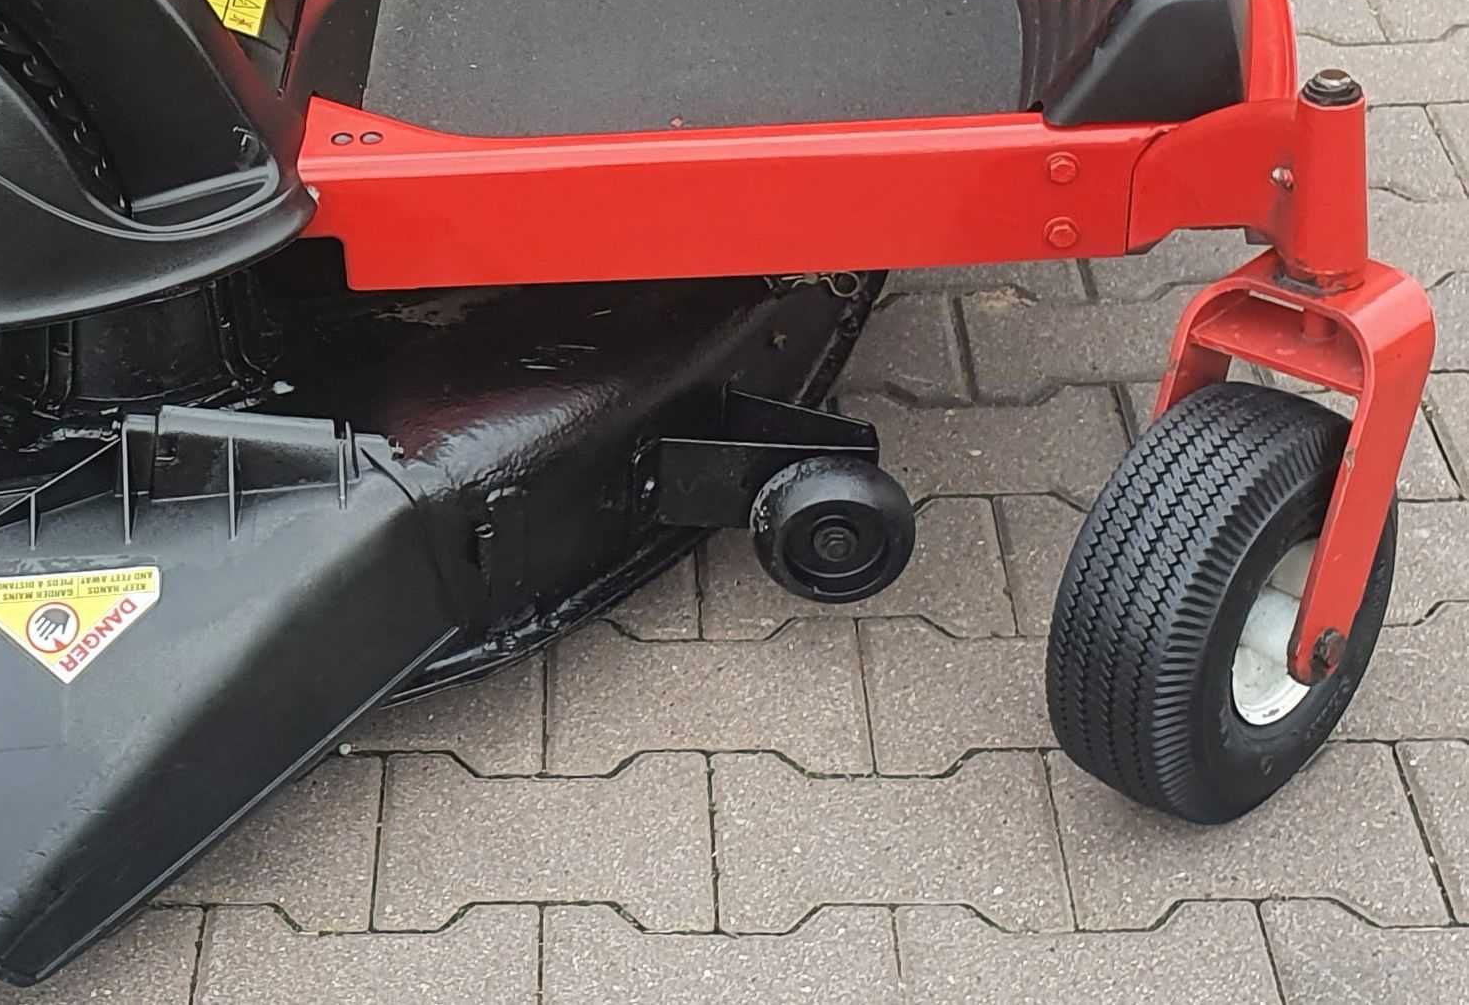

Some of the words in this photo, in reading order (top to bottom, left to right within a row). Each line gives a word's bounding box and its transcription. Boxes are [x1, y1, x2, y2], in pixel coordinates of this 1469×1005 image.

[80, 575, 107, 584] AWAY
[110, 574, 131, 582] FEET
[133, 572, 153, 580] AND
[88, 586, 119, 594] HANDS
[123, 584, 146, 592] KEEP
[3, 592, 33, 600] MAINS
[59, 597, 138, 672] DANGER
